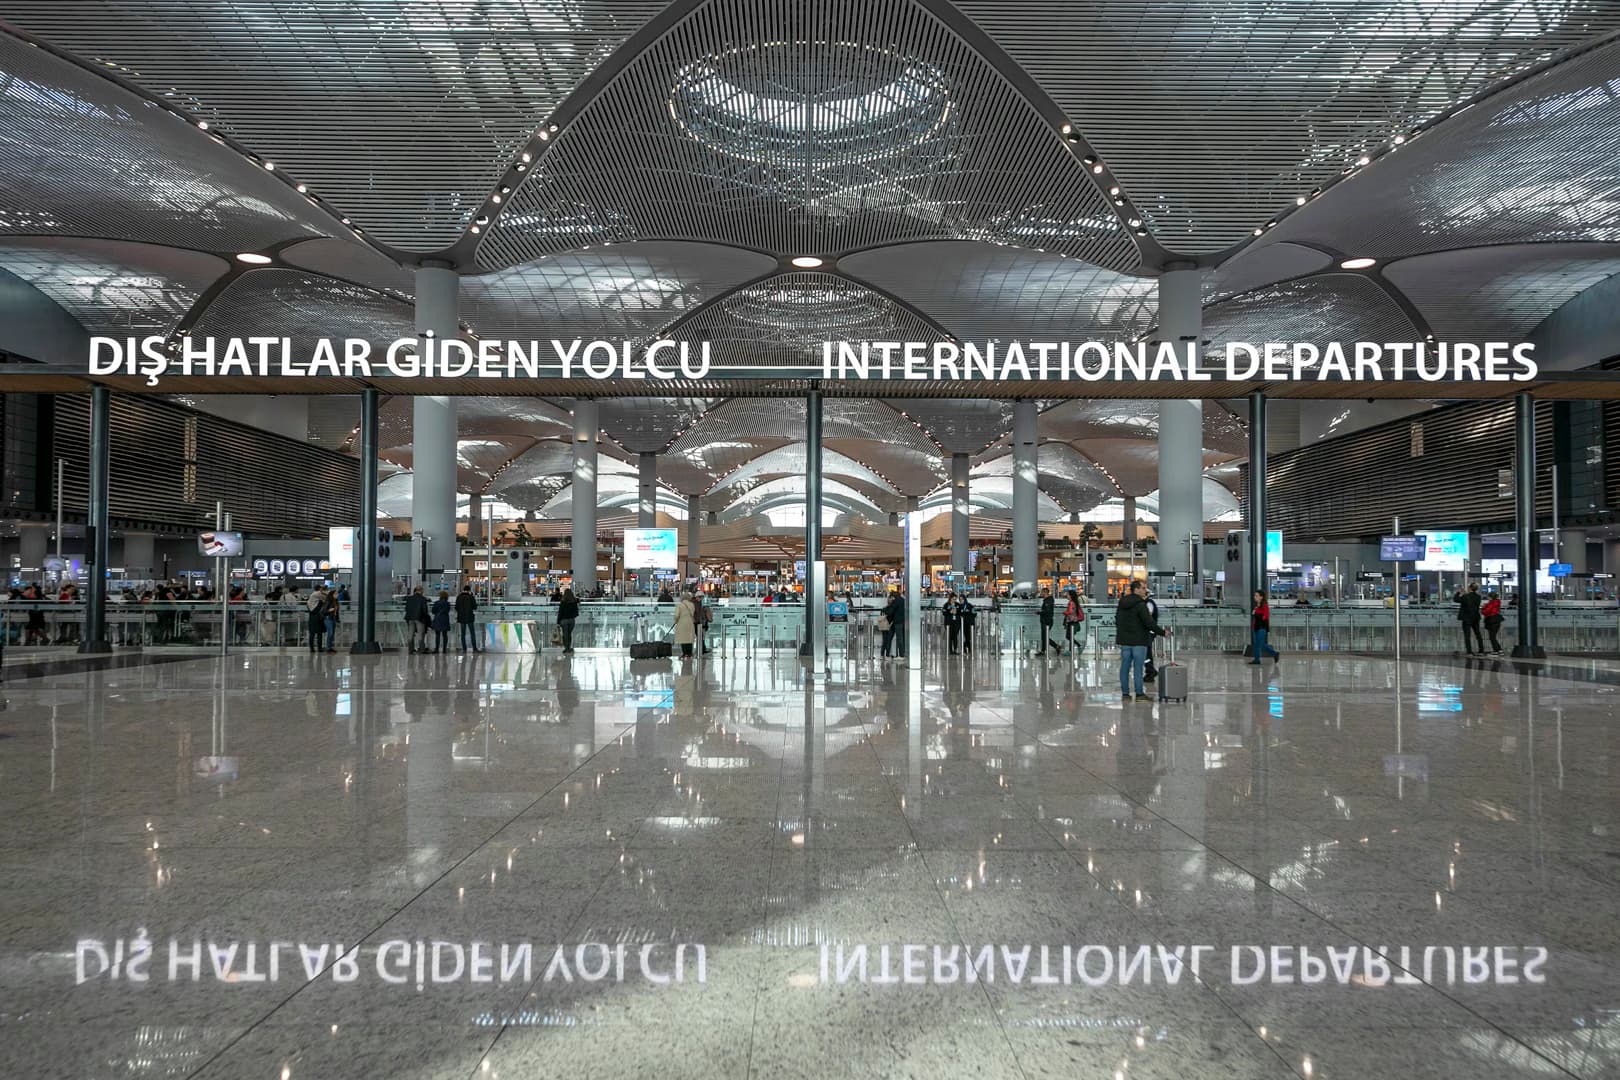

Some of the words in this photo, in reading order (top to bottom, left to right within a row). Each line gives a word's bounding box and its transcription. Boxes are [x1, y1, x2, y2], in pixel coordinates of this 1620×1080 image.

[88, 336, 167, 387] DIŞ
[182, 336, 372, 377] HATLAR
[386, 330, 538, 378] GİDEN
[550, 340, 710, 379] YOLCU
[823, 341, 1211, 381] INTERNATIONAL
[1226, 342, 1538, 381] DEPARTURES
